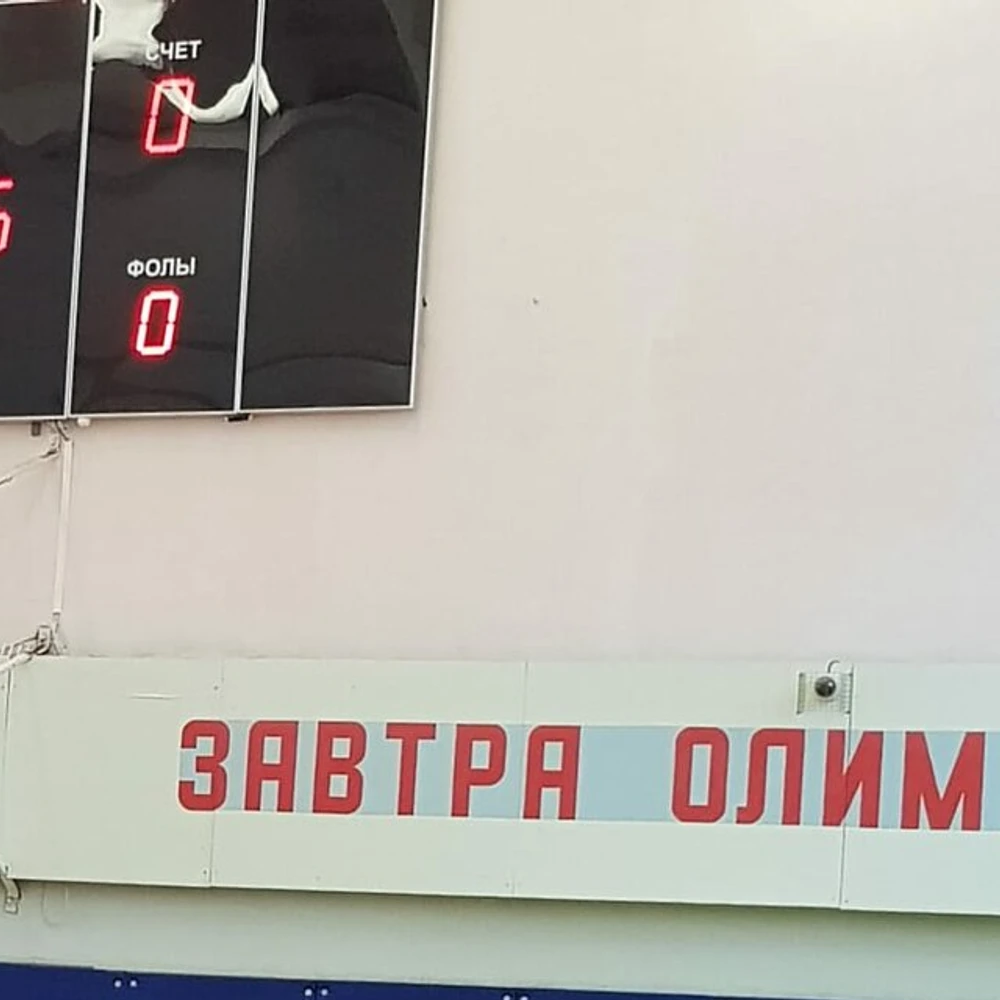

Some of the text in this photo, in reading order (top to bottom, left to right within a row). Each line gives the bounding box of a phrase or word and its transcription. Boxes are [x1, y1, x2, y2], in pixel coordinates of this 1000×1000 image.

[145, 39, 203, 62] СЧЕТ
[144, 76, 195, 154] 0
[127, 256, 197, 278] ФОЛЫ
[135, 289, 180, 357] 0
[178, 719, 987, 832] ЗАВТРА ОЛИМ
